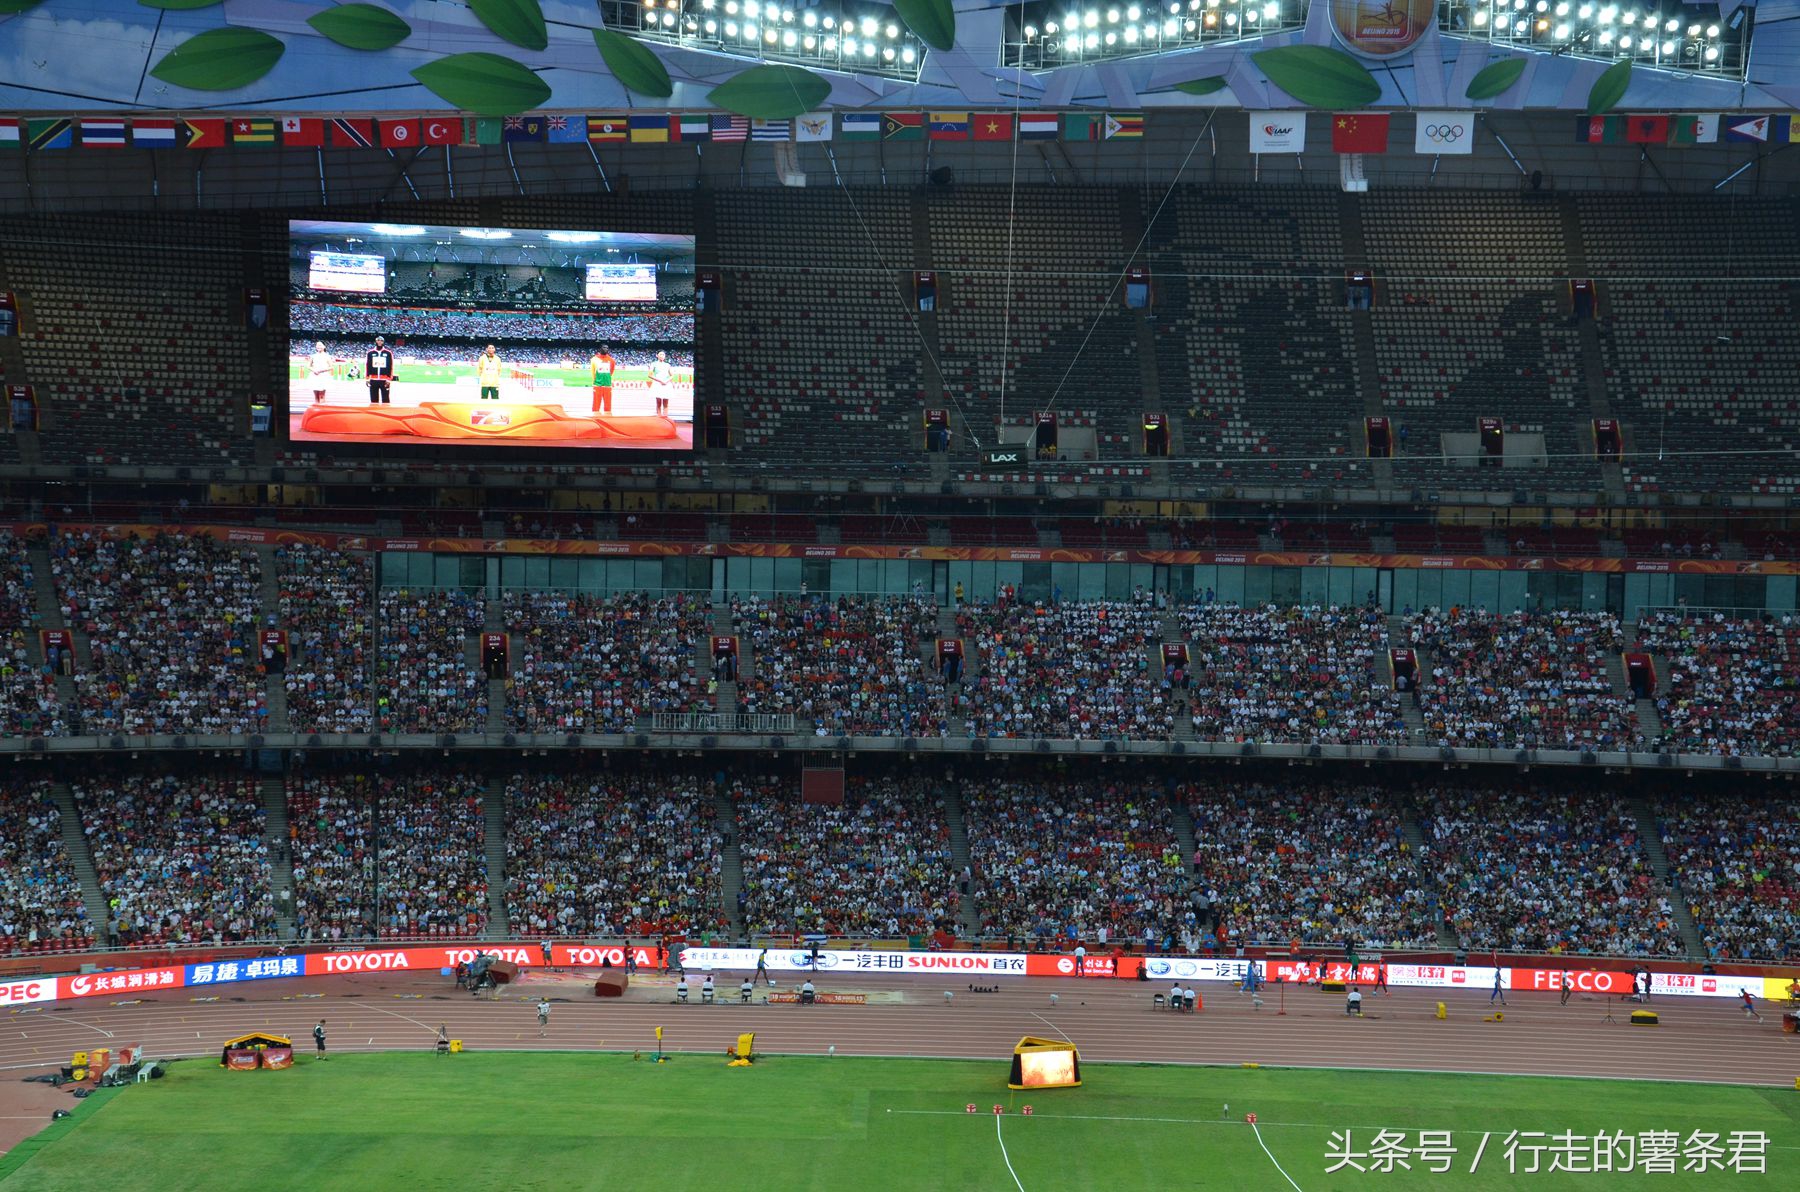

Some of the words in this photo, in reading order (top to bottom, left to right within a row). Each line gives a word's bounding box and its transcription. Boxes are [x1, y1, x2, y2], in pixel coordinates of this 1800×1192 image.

[991, 453, 1017, 462] LAX
[323, 952, 409, 972] TOYOTA
[566, 948, 650, 965] TOYOA
[842, 954, 903, 968] 一汽丰田
[908, 956, 988, 970] SUNLON
[993, 958, 1025, 970] 首农
[192, 958, 298, 984] 易捷·卓玛泉
[95, 971, 174, 991] 长城润滑油
[1534, 971, 1613, 990] FESCO
